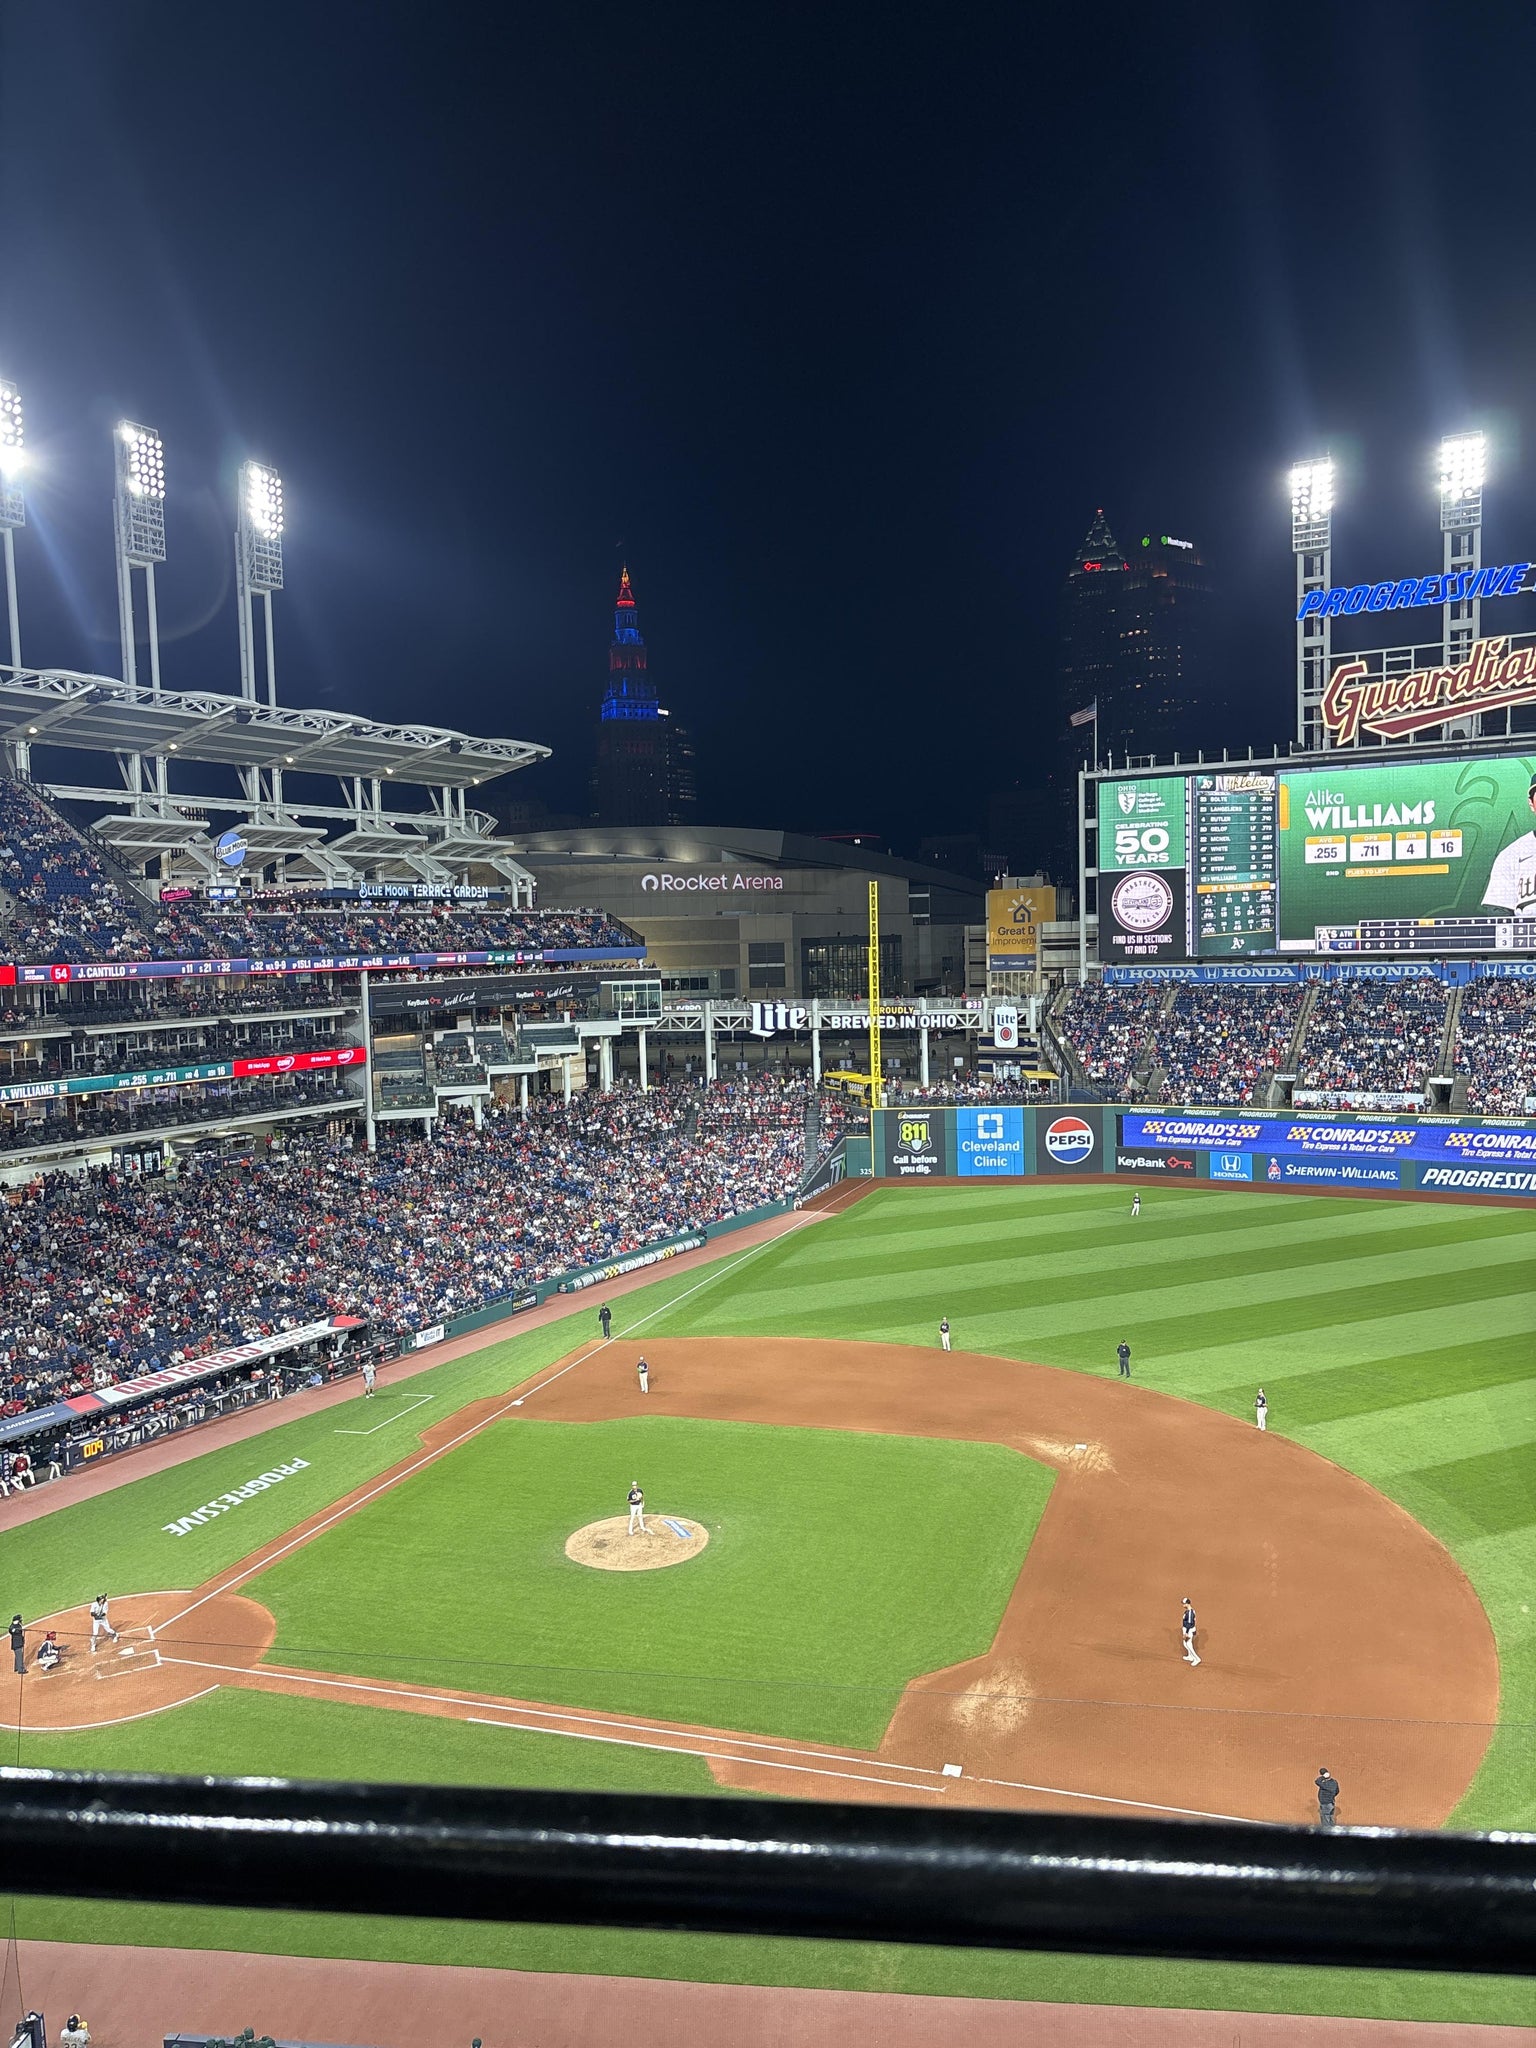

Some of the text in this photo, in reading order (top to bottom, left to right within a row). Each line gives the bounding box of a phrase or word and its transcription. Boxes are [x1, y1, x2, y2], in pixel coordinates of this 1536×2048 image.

[1296, 562, 1532, 621] PROGRESSIVE
[1321, 636, 1536, 746] Guardia
[1305, 789, 1344, 806] Alika
[1305, 800, 1435, 830] WILLIAMS
[1115, 821, 1168, 830] CELEBRATING
[1114, 828, 1169, 854] 50
[217, 841, 247, 857] BLUE MOON
[1314, 841, 1454, 859] .255 .711 4 16
[1115, 852, 1169, 865] YEARS
[661, 873, 783, 891] Rocket Arena
[1124, 880, 1160, 894] MASTHEAD
[359, 882, 489, 898] BLUE MOON TERRACE GARDEN
[997, 926, 1025, 936] Great
[1340, 930, 1353, 938] ATH
[1394, 929, 1400, 937] 0
[992, 937, 1037, 946] Improvem
[1113, 934, 1173, 945] FIND US IN SECTIONS
[1338, 941, 1352, 949] CLE
[1124, 944, 1158, 954] 117 AND 172
[187, 963, 231, 973] 11 21 32
[255, 961, 264, 970] 32
[322, 959, 333, 968] 3.81
[55, 966, 125, 979] 54 J. CANTILLO
[1129, 969, 1199, 978] HONDA
[1222, 967, 1296, 977] HONDA
[1356, 966, 1435, 976] HONDA
[407, 999, 429, 1007] KeyBank
[750, 1002, 806, 1038] Lite
[831, 1015, 957, 1029] BREWED IN OHIO
[997, 1014, 1015, 1026] Lite
[131, 1075, 147, 1085] .255
[153, 1075, 163, 1083] OPS
[164, 1072, 177, 1082] .711
[194, 1069, 199, 1078] 4
[217, 1066, 225, 1075] 16
[0, 1084, 55, 1100] A. WILLIAMS
[1417, 1117, 1460, 1125] PROGRESSIVE
[1481, 1119, 1527, 1127] PROGRESSIVE
[901, 1122, 927, 1141] 811
[1165, 1121, 1238, 1137] CONRAD'S
[1049, 1135, 1091, 1146] PEPSI
[1168, 1136, 1192, 1145] Express
[1311, 1127, 1391, 1144] CONRAD'S
[961, 1141, 1020, 1153] Cleveland
[1315, 1142, 1341, 1151] Express
[1349, 1143, 1365, 1151] Total
[1379, 1145, 1396, 1153] Care
[893, 1155, 938, 1164] Call before
[1461, 1148, 1475, 1156] Tire
[1476, 1149, 1505, 1158] Express
[1505, 1150, 1513, 1158] &
[1513, 1150, 1531, 1159] Total
[974, 1155, 1008, 1167] Clinic
[1117, 1156, 1166, 1169] KeyBank
[900, 1164, 931, 1175] you dig.
[1213, 1171, 1248, 1179] HONDA
[112, 1346, 263, 1395] CLEVELAND
[161, 1457, 312, 1537] PROGRESSIVE
